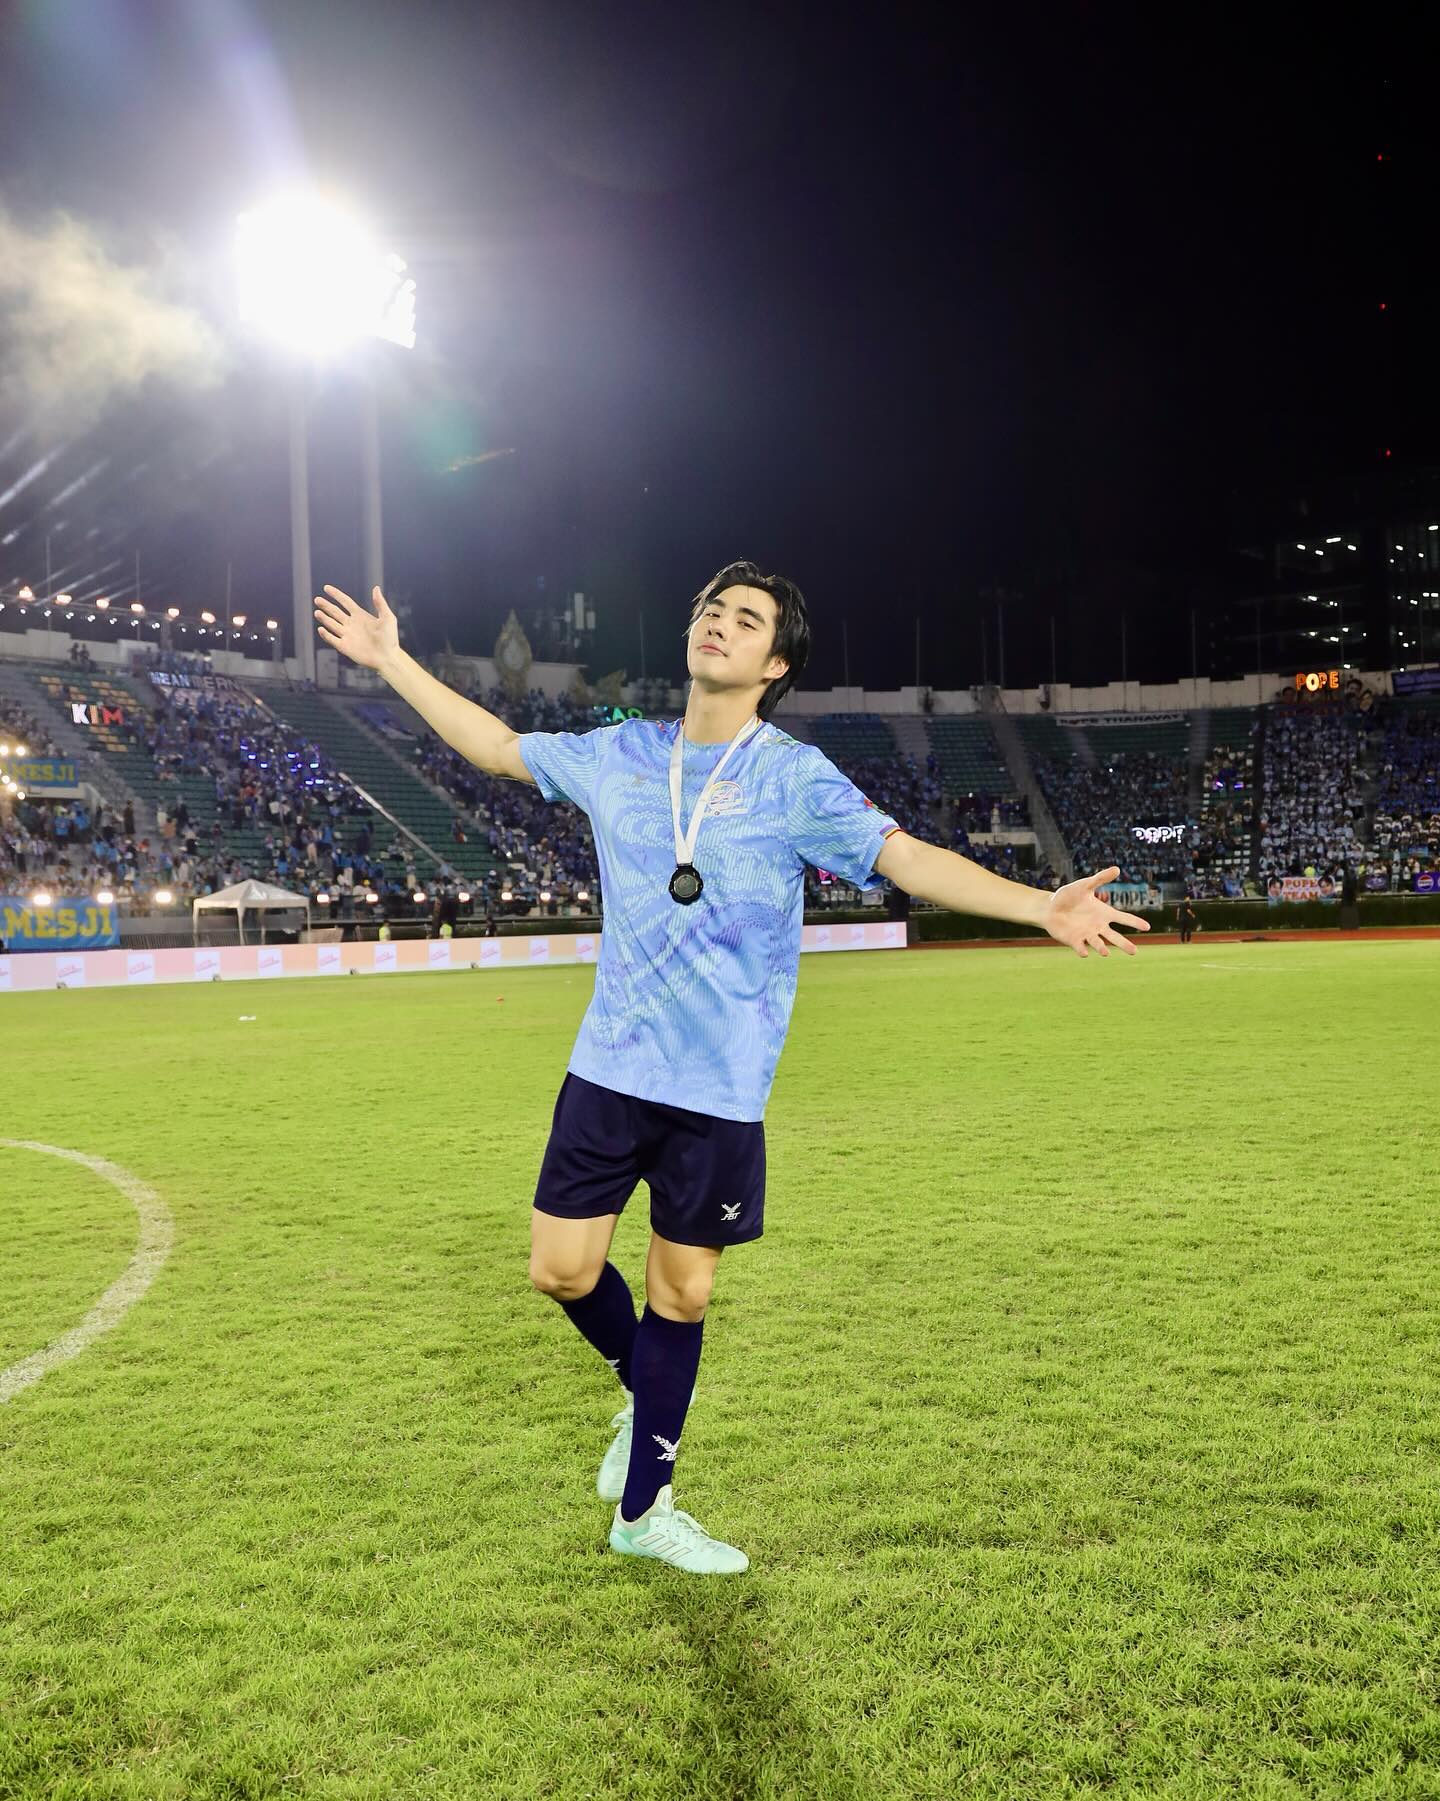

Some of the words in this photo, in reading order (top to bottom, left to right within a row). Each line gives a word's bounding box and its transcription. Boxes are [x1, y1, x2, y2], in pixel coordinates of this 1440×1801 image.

[1296, 671, 1339, 691] POPE
[72, 703, 124, 725] KIM
[1283, 878, 1319, 888] POPE
[1282, 891, 1319, 900] TEAM
[0, 906, 113, 938] MESJI
